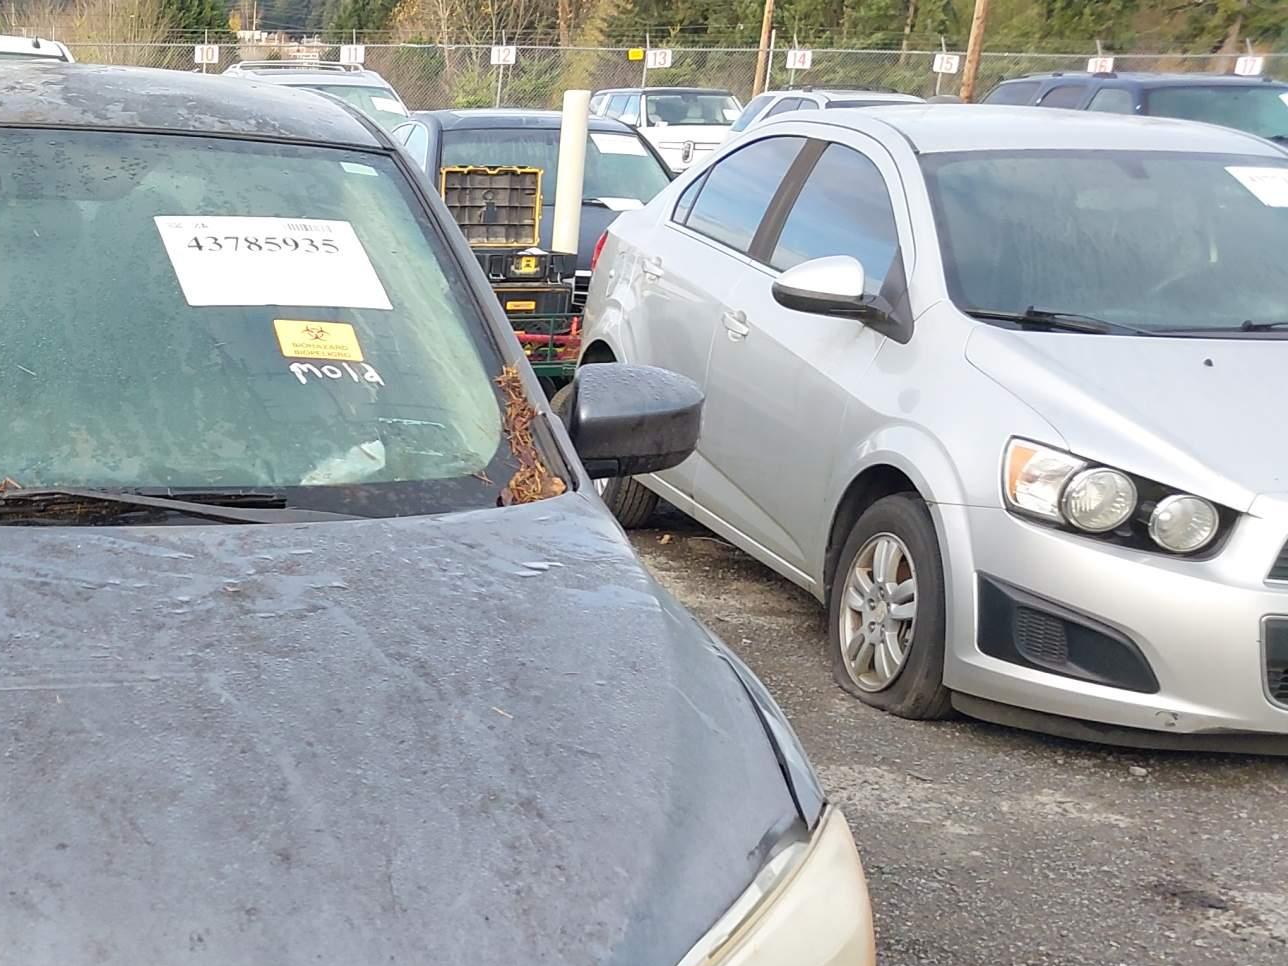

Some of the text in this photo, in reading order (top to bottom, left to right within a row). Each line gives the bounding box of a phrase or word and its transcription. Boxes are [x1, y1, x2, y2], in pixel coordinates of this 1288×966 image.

[199, 46, 215, 62] 10
[347, 46, 358, 62] 11
[495, 48, 512, 63] 12
[652, 51, 668, 66] 13
[791, 52, 807, 67] 14
[939, 56, 954, 71] 15
[1094, 58, 1109, 72] 16
[1243, 58, 1257, 74] 17
[186, 235, 340, 254] 43785935
